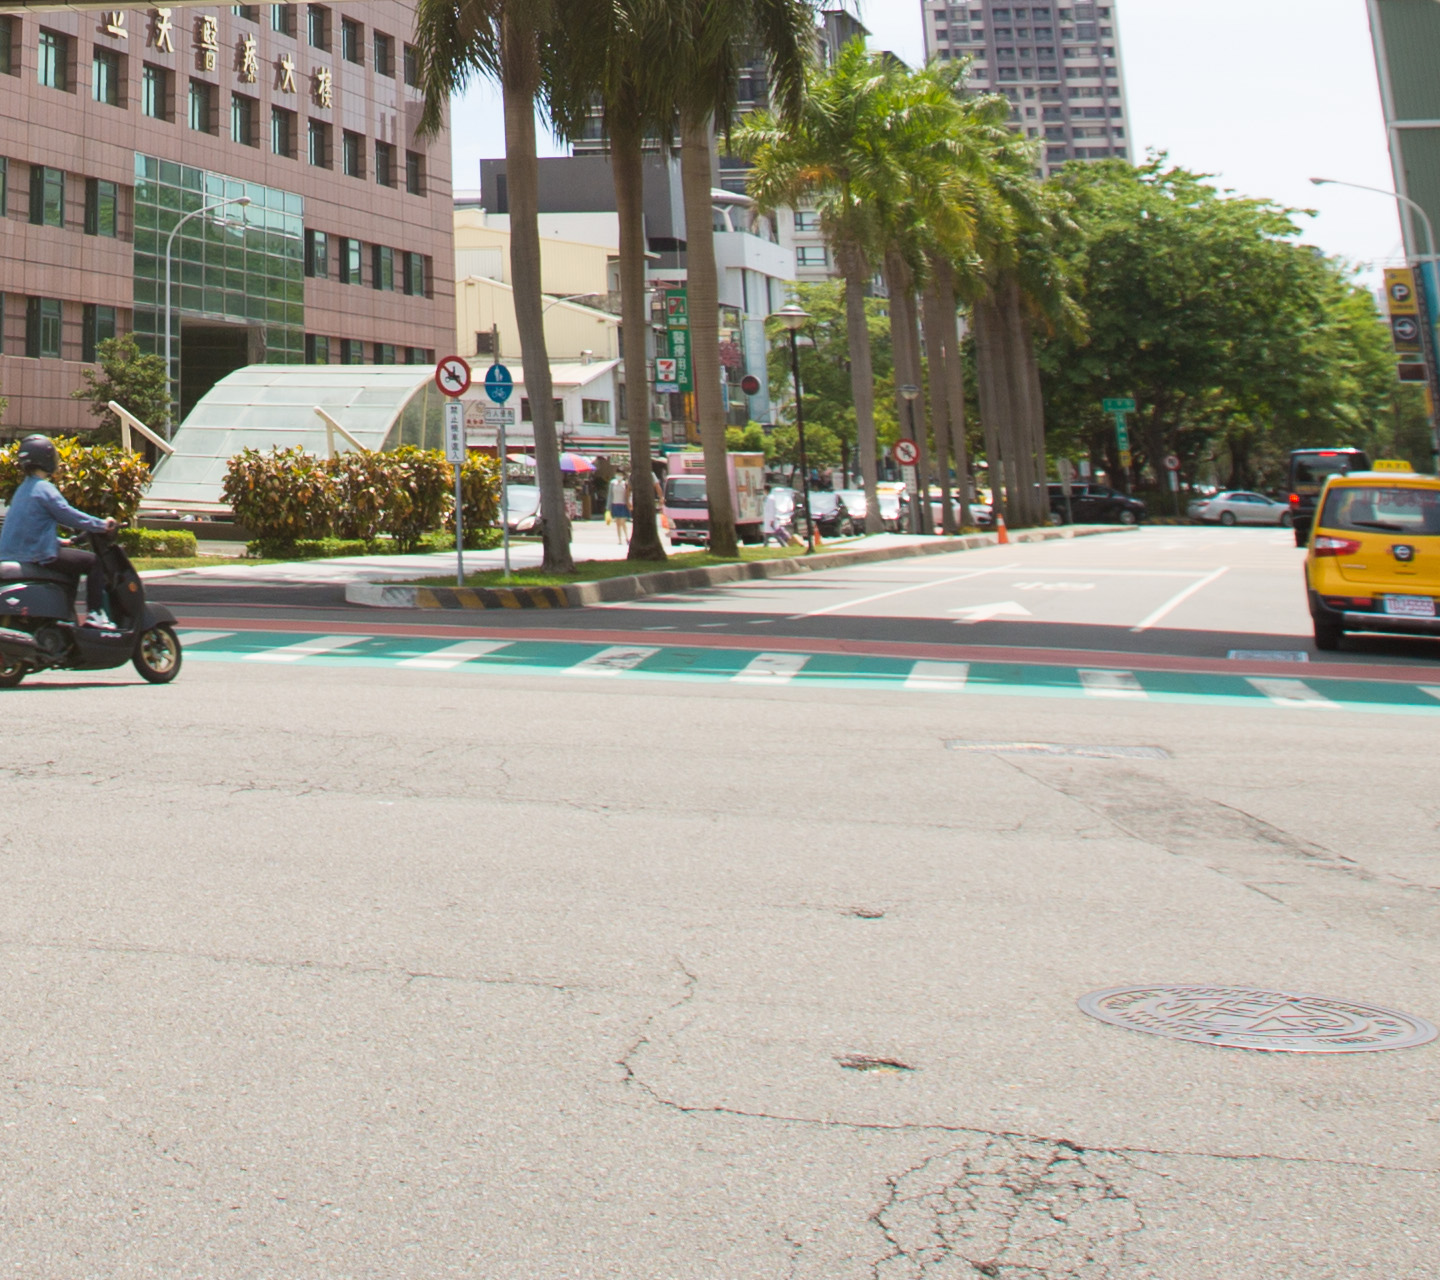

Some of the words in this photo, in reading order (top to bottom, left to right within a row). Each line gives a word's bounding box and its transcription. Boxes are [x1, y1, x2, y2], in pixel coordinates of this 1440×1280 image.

[672, 330, 688, 384] 醫療用品
[450, 405, 460, 460] 禁止機車進入
[485, 409, 514, 419] 行人優先
